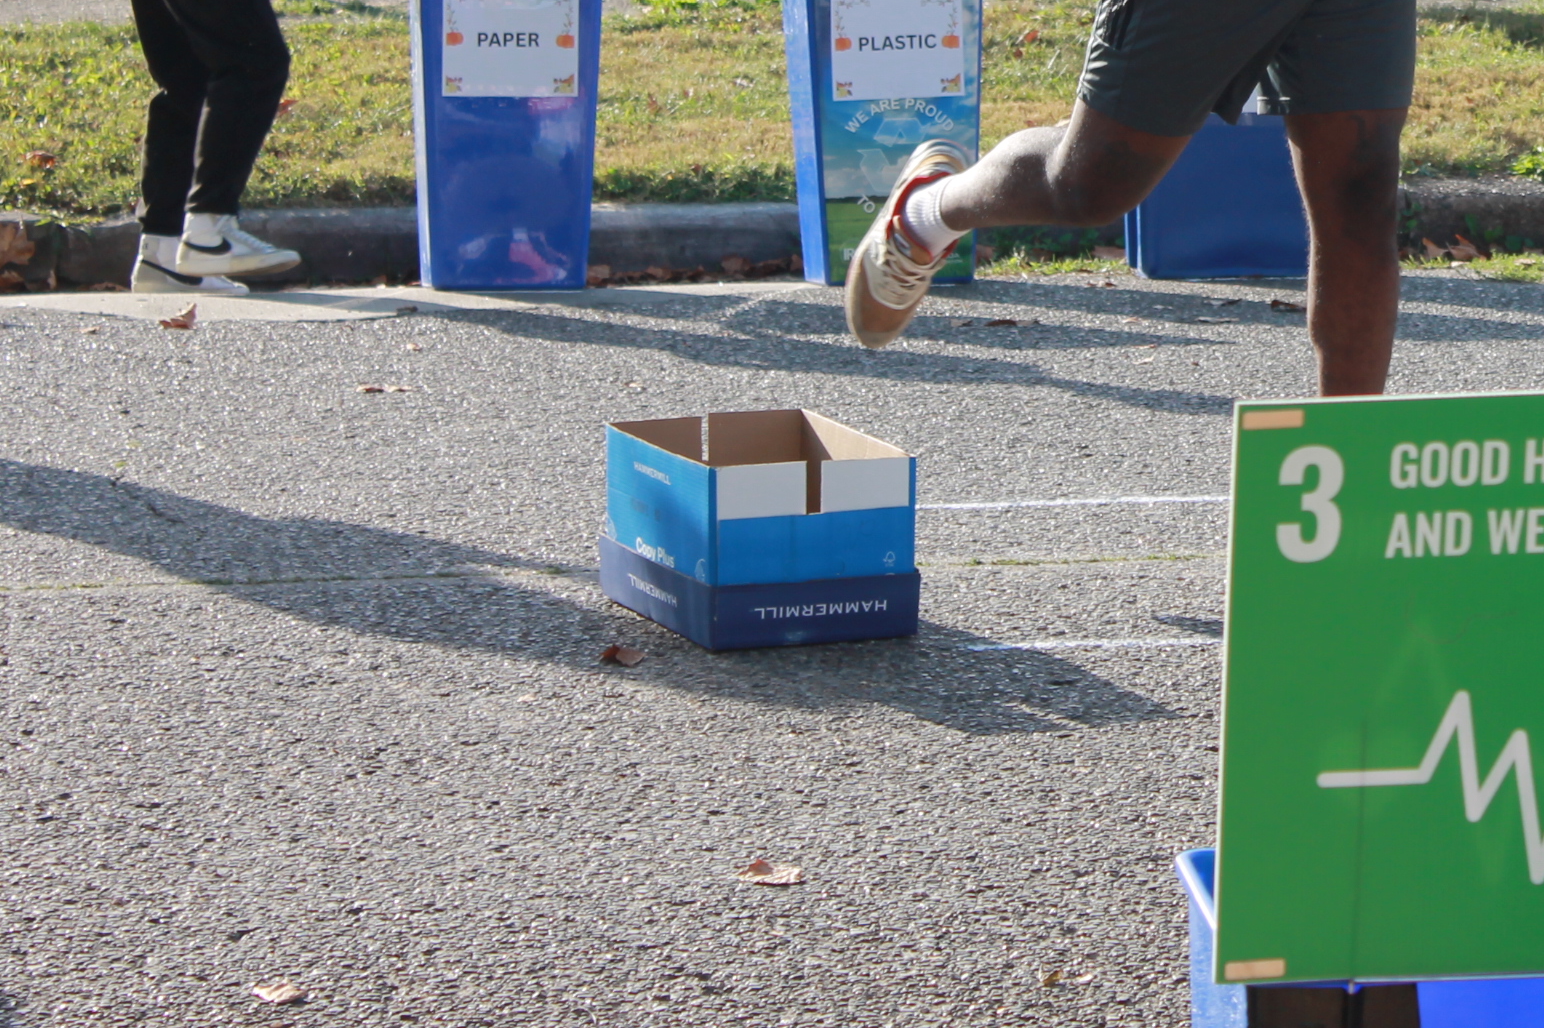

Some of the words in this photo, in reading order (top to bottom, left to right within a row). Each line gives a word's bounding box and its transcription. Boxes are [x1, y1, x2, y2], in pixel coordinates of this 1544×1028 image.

[477, 32, 540, 48] PAPER
[858, 34, 938, 52] PLASTIC
[844, 110, 870, 134] WE
[869, 98, 901, 116] ARE
[904, 98, 955, 132] PROUD
[857, 193, 876, 213] TO
[1275, 444, 1345, 564] 3
[1389, 439, 1510, 490] GOOD
[1384, 509, 1473, 560] AND
[635, 536, 657, 562] Copy
[656, 545, 676, 569] Plus
[754, 599, 888, 620] HAMMERMILL
